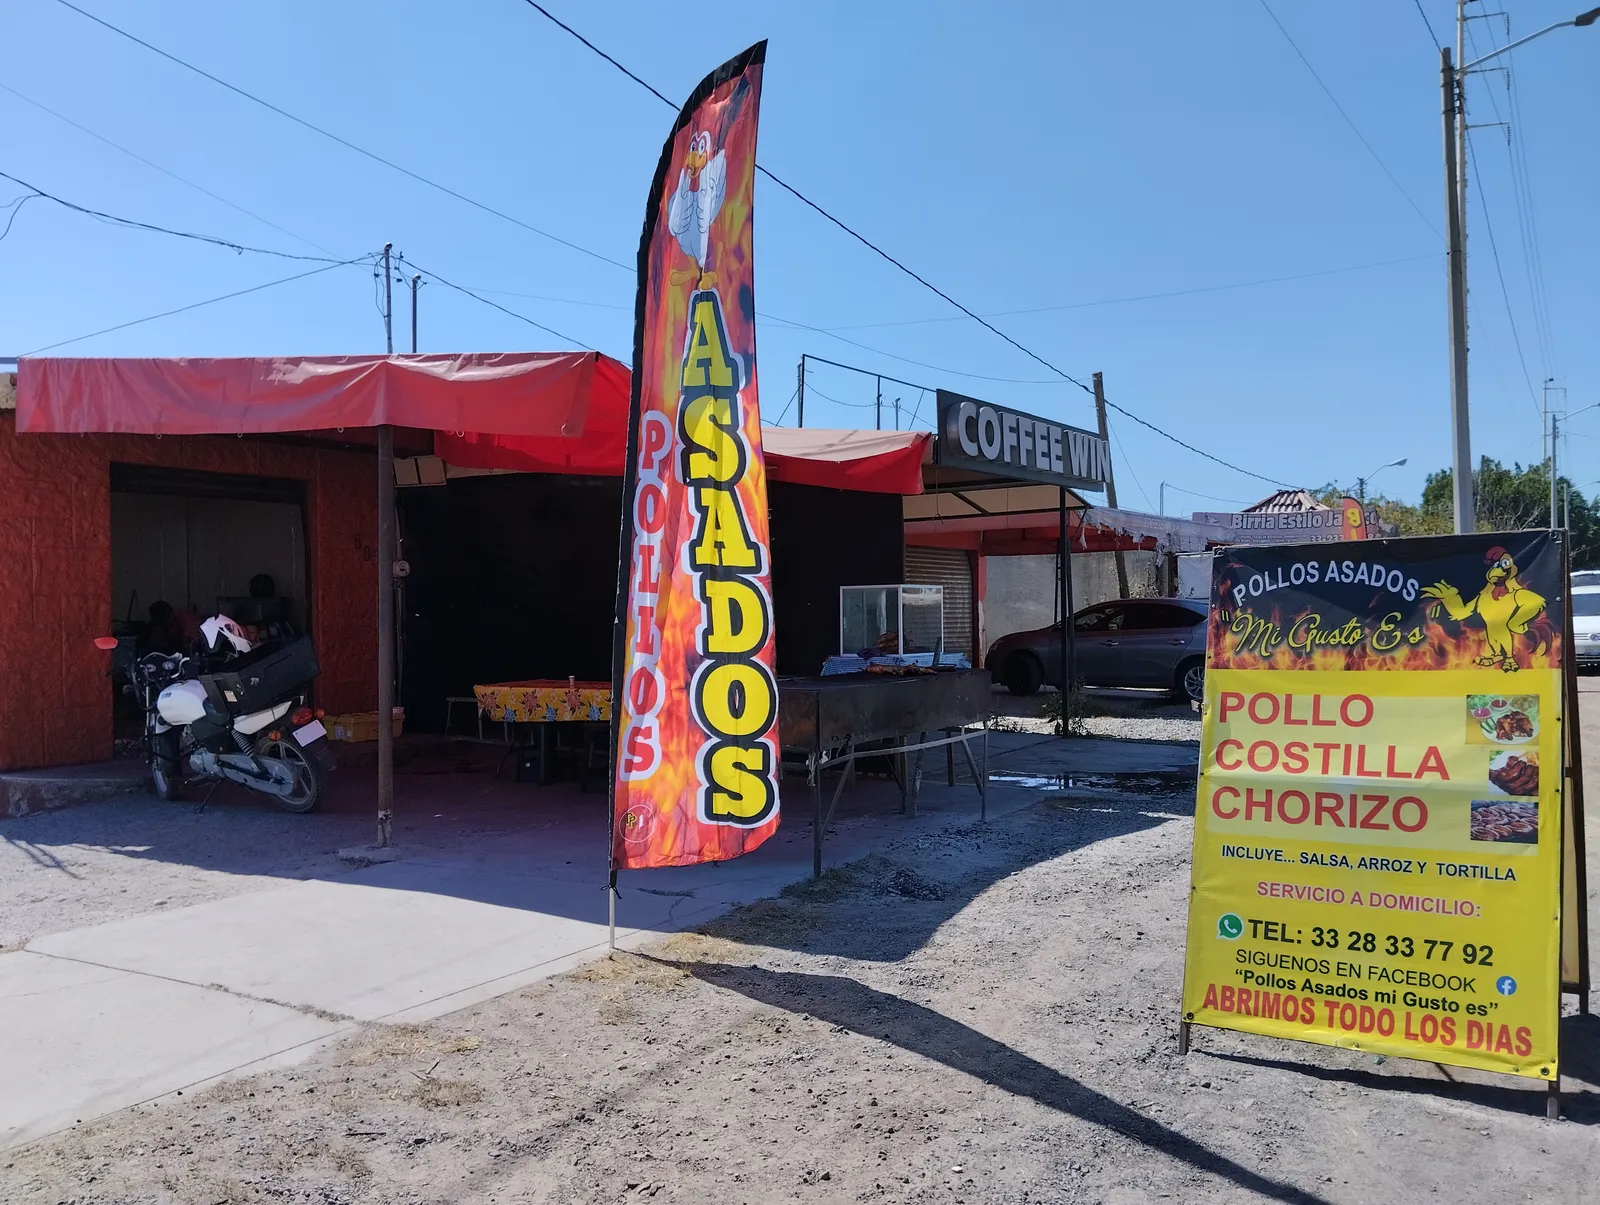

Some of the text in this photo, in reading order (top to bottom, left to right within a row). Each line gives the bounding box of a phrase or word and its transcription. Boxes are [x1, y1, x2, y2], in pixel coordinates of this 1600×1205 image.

[957, 402, 1111, 483] COFFEE WIN
[1230, 513, 1276, 530] Birria
[1278, 512, 1323, 529] Estilo
[680, 294, 775, 823] ASADOS
[622, 415, 669, 777] POLLOS
[1233, 560, 1420, 607] POLLOS ASADOS
[1288, 614, 1365, 652] Gusto
[1218, 691, 1374, 728] POLLO
[1215, 739, 1450, 781] COSTILLA
[1212, 785, 1429, 833] CHORIZO
[1221, 844, 1516, 882] INCLUYE... SALSA, ARROZ Y TORTILLA
[1257, 880, 1481, 919] SERVICIO A DOMICILIO:
[1248, 918, 1494, 967] TEL: 33 28 33 77 92
[1236, 949, 1477, 993] SIGUENOS EN FACEBOOK
[1301, 978, 1369, 1001] Asados
[1374, 989, 1397, 1005] mi
[1402, 991, 1460, 1013] Gusto
[1202, 983, 1533, 1057] ABRIMOS TODO LOS DIAS
